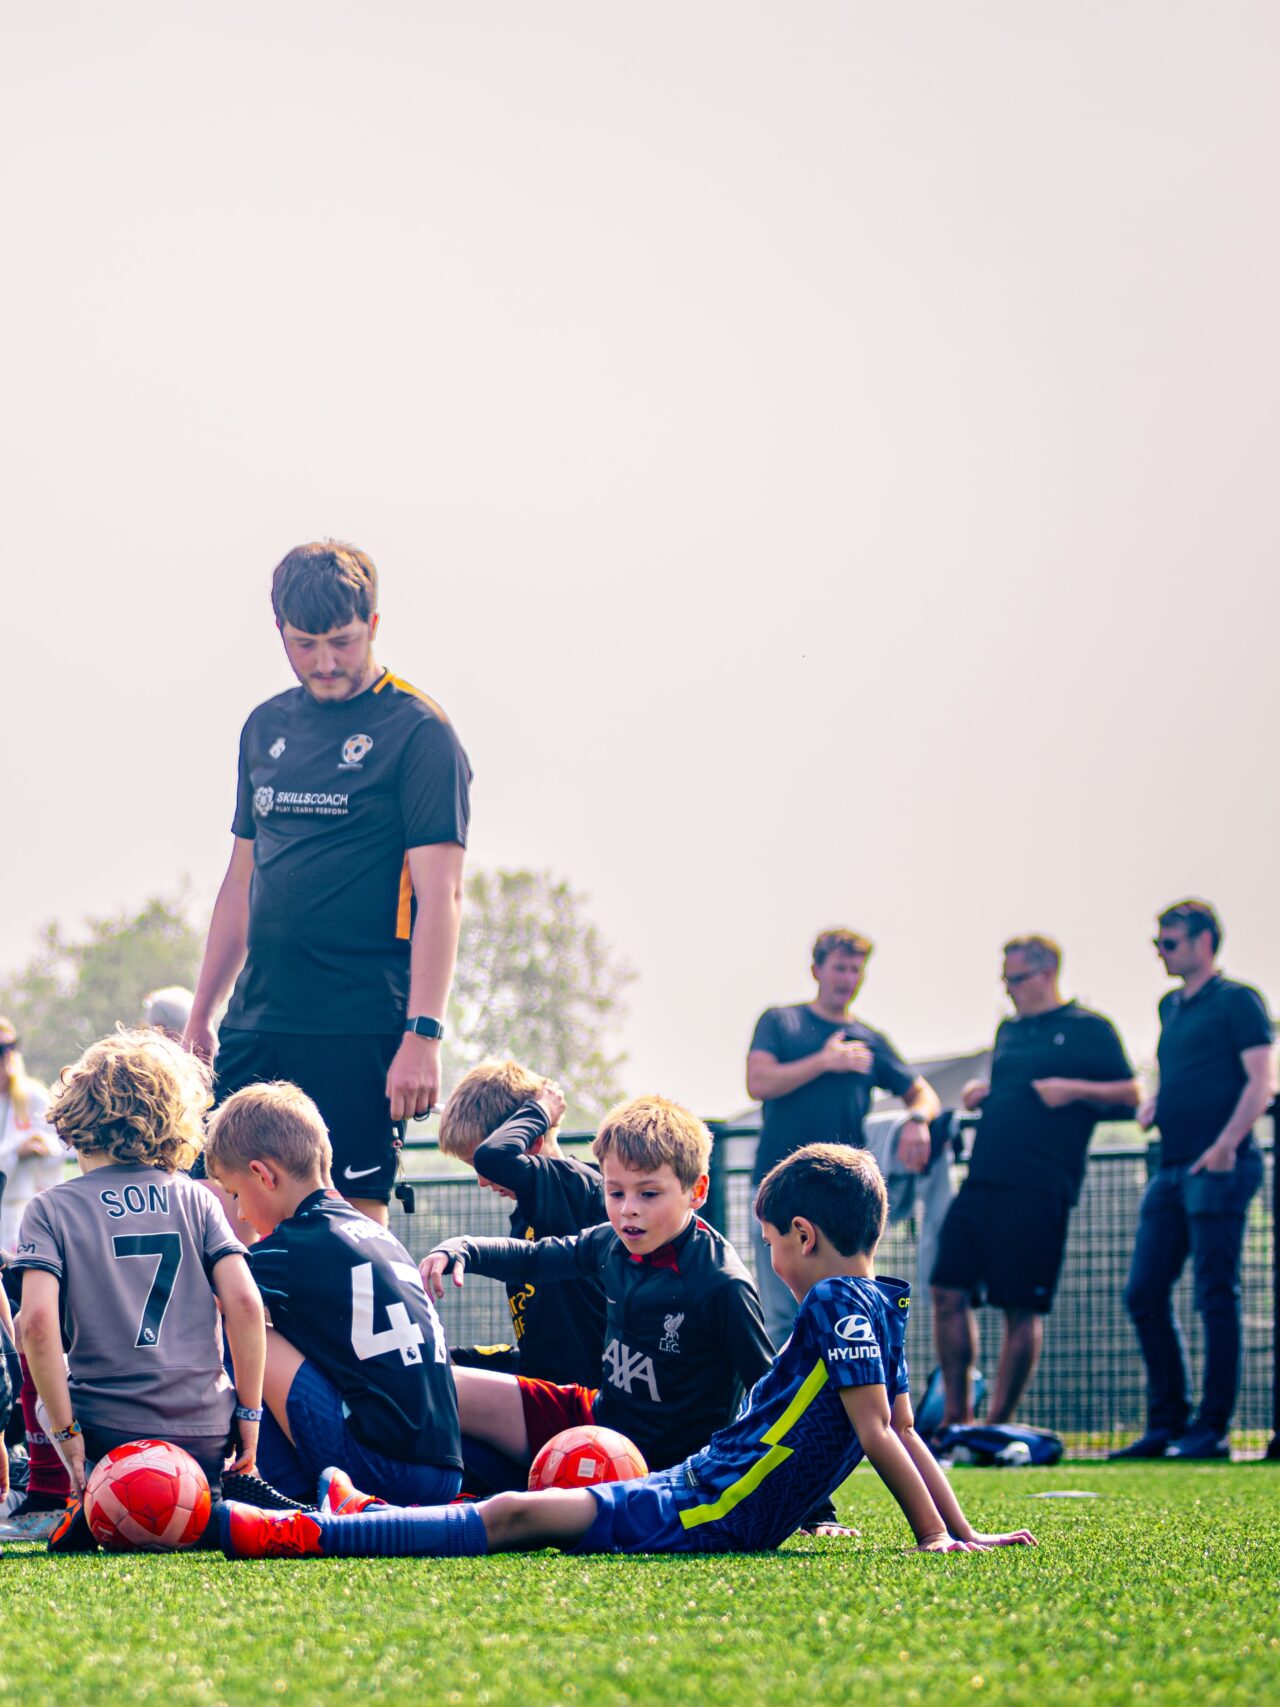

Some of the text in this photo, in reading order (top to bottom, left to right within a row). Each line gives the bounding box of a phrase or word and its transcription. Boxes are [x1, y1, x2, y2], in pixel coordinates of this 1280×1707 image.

[276, 791, 349, 806] SKILLSCOACH
[100, 1184, 170, 1218] SON
[111, 1231, 184, 1349] 7
[827, 1345, 881, 1361] HYUND
[601, 1338, 662, 1403] AXA
